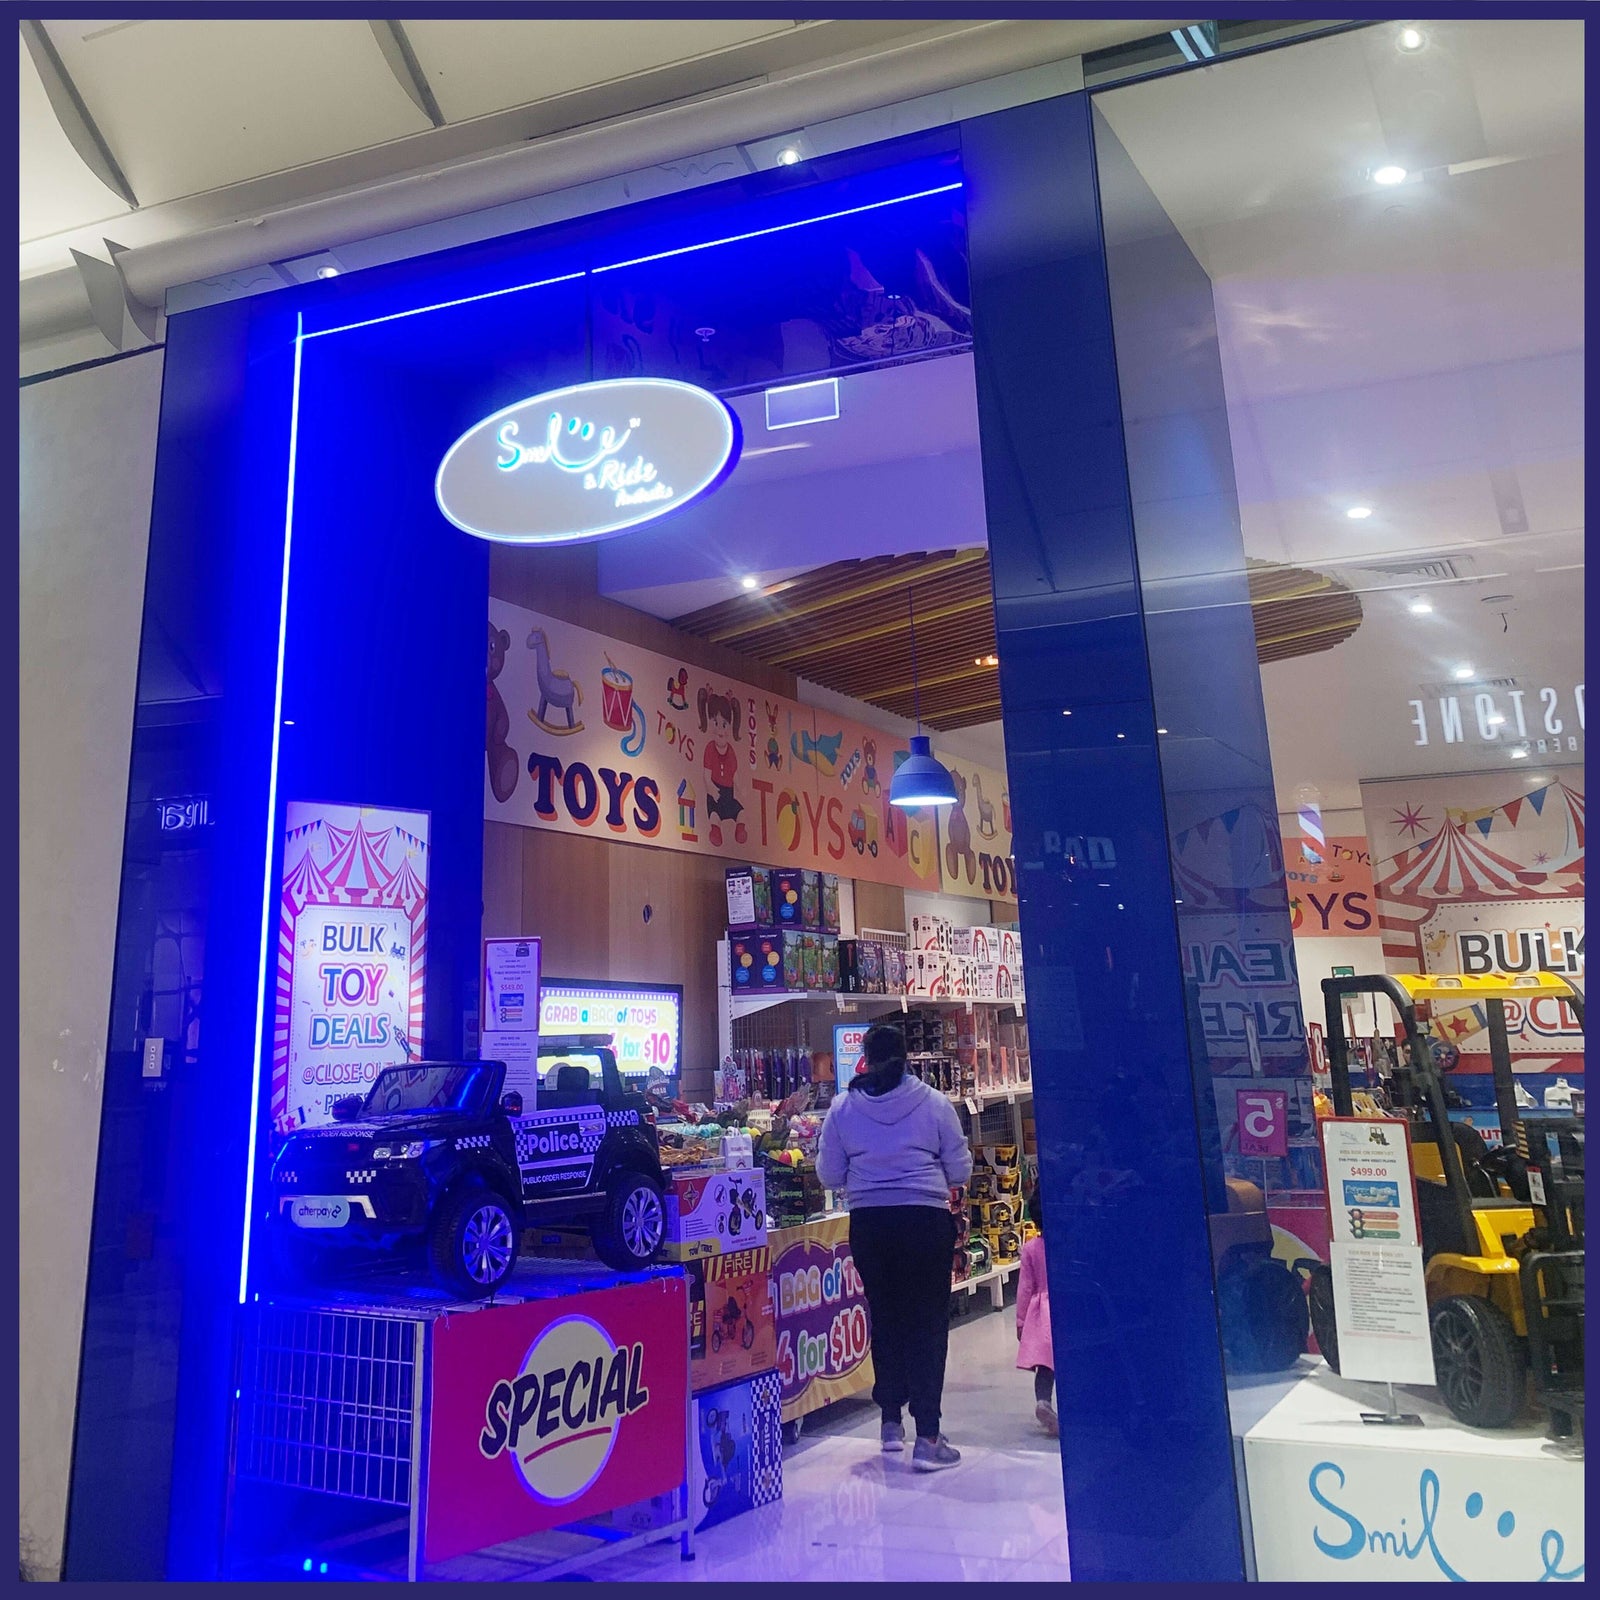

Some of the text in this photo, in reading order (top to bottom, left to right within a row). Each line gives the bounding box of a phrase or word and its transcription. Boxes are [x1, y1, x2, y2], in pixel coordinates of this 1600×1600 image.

[598, 455, 657, 490] Ride
[656, 710, 695, 762] TOYS
[528, 752, 662, 838] TOYS
[752, 778, 846, 860] TOYS
[1285, 871, 1318, 883] OYS
[323, 925, 385, 953] BULK
[324, 968, 384, 1002] TOY
[545, 1005, 578, 1023] GRAB
[581, 1009, 589, 1023] a
[592, 1008, 614, 1024] BAG
[616, 1008, 628, 1024] of
[311, 1017, 389, 1046] DEALS
[843, 1032, 868, 1045] GR
[622, 1037, 640, 1058] for
[644, 1032, 671, 1065] $10
[303, 1060, 395, 1084] @CLOSE-OU
[528, 1131, 580, 1156] Police
[522, 1170, 587, 1185] PUBLIC ORDER RESPONSE
[1350, 1166, 1388, 1177] $499.00
[298, 1205, 332, 1218] afterpay
[724, 1256, 752, 1273] FIRE
[781, 1268, 821, 1311] BAG
[824, 1261, 841, 1298] of
[778, 1309, 866, 1381] 4 for $10
[481, 1344, 648, 1457] SPECIAL
